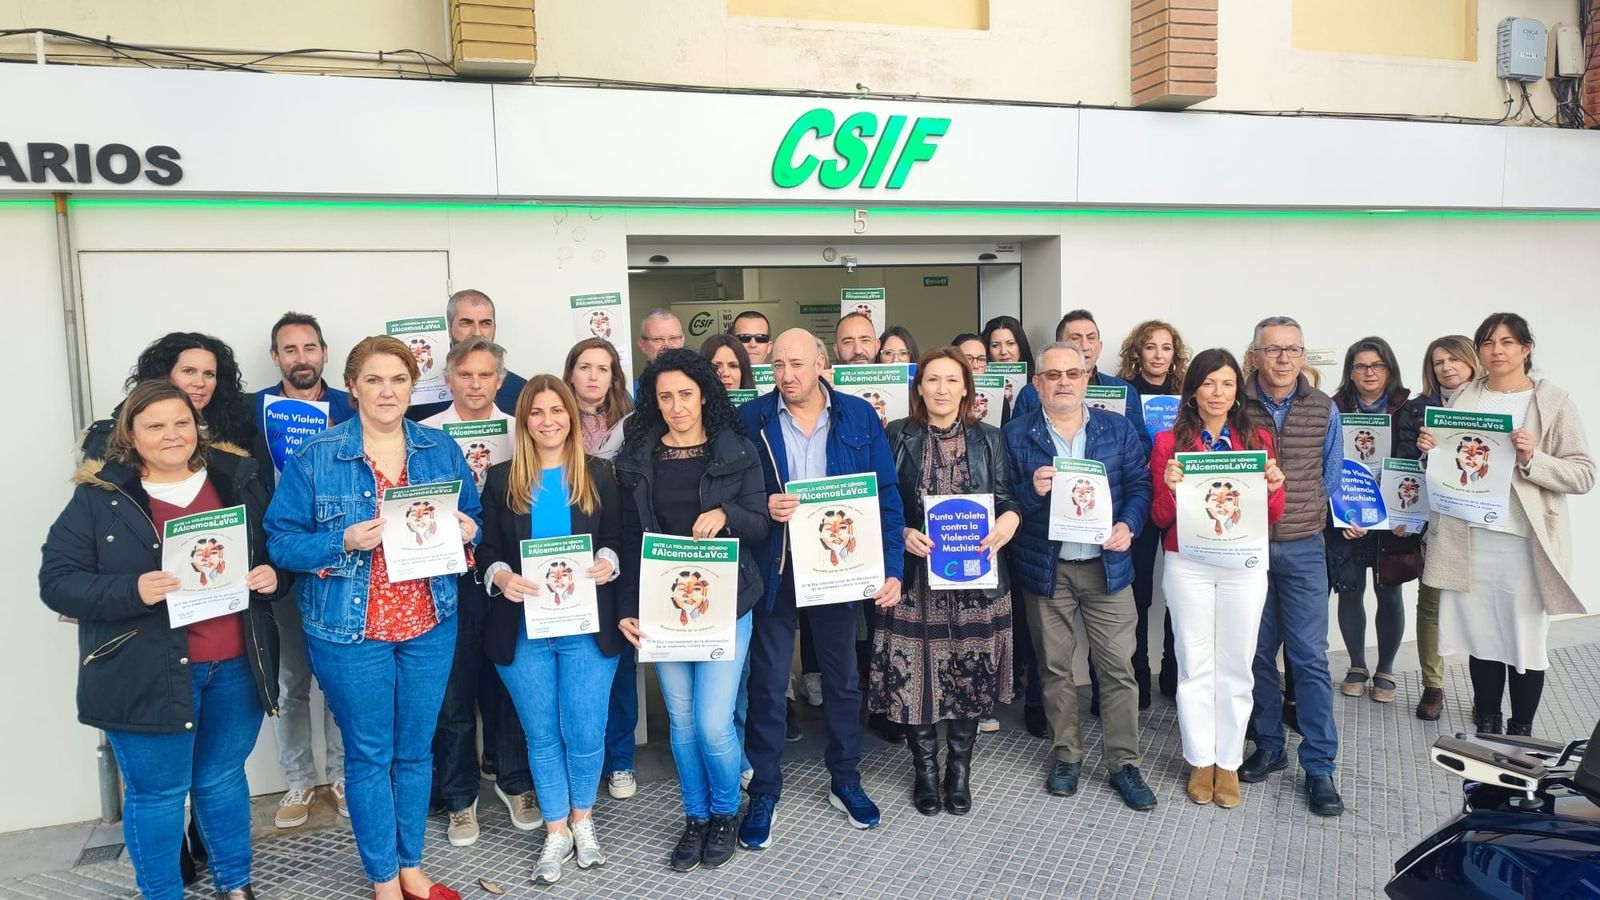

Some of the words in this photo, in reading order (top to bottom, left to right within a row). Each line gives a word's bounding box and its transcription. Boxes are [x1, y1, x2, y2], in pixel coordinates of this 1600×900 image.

[771, 108, 952, 189] CSIF
[0, 142, 183, 186] ARIOS
[853, 209, 868, 234] 5
[693, 319, 714, 328] CSIF
[267, 410, 289, 420] Punto
[292, 414, 325, 424] Violeta
[1433, 418, 1505, 430] #AlcemosLaVoz
[287, 427, 316, 435] contra
[449, 427, 502, 436] #AlcemosLaVoz
[1185, 462, 1258, 471] #AlcemosLaVoz
[1342, 476, 1364, 485] contra
[1341, 484, 1374, 494] Violencia
[1342, 494, 1376, 502] Machista
[930, 513, 953, 521] Punto
[955, 512, 986, 520] Violeta
[173, 517, 239, 533] #AlcemosLaVoz
[941, 523, 968, 531] contra
[970, 521, 978, 530] la
[941, 533, 980, 541] Violencia
[528, 544, 584, 555] #AlcemosLaVoz
[942, 544, 979, 552] Machista
[652, 548, 728, 559] #AlcemosLaVoz
